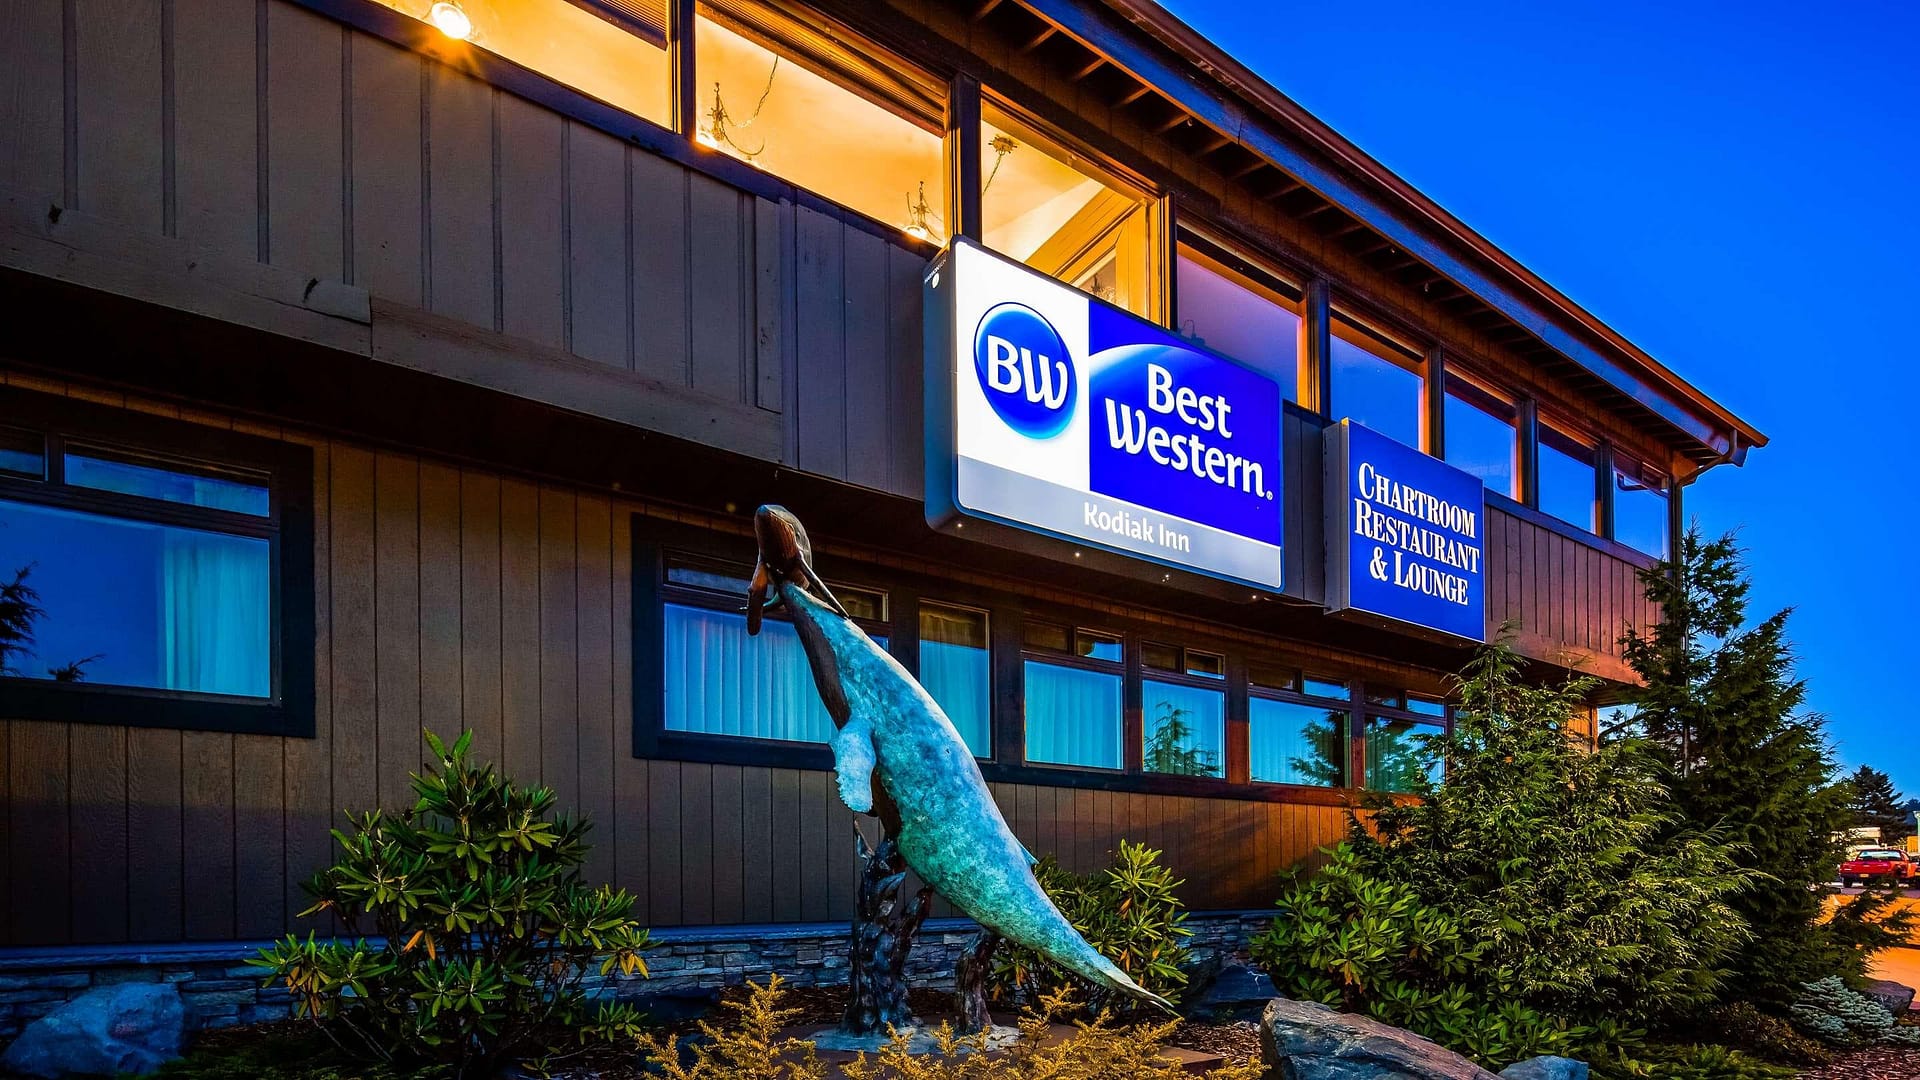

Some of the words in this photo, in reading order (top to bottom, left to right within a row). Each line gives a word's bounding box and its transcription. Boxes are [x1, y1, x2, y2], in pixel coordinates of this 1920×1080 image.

[986, 334, 1069, 411] BW
[1147, 362, 1232, 439] Best
[1083, 502, 1154, 544] Kodiak
[1158, 526, 1191, 553] Inn
[1354, 498, 1480, 574] RESTAURANT
[1358, 462, 1476, 539] CHARTROOM
[1369, 546, 1388, 582] &
[1394, 551, 1468, 606] LOUNGE
